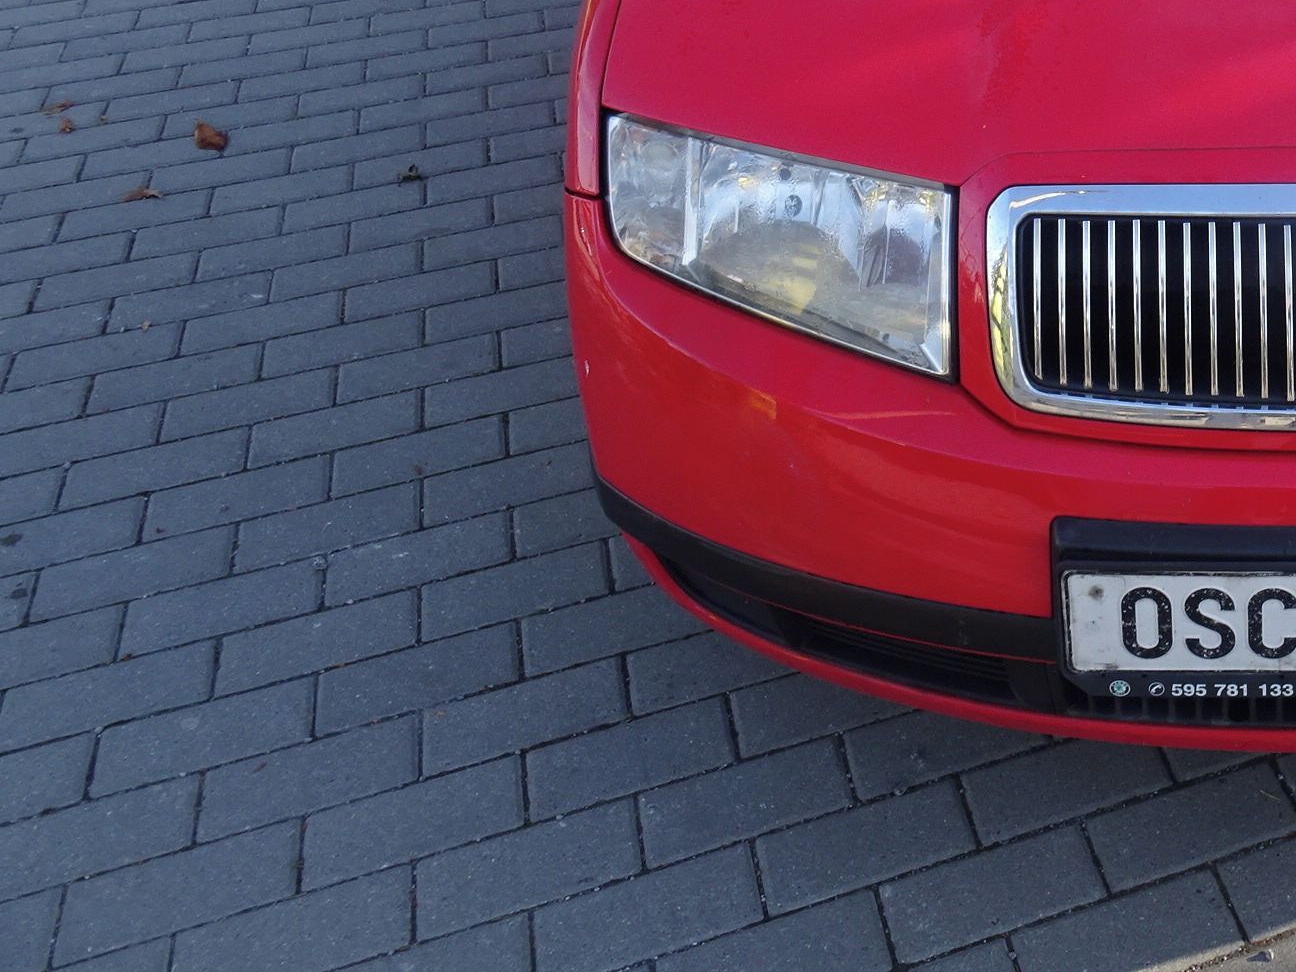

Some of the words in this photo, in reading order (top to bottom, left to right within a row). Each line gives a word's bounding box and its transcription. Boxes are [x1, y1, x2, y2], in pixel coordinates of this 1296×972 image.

[1171, 683, 1207, 697] 595
[1214, 683, 1248, 697] 781
[1258, 683, 1294, 697] 133
